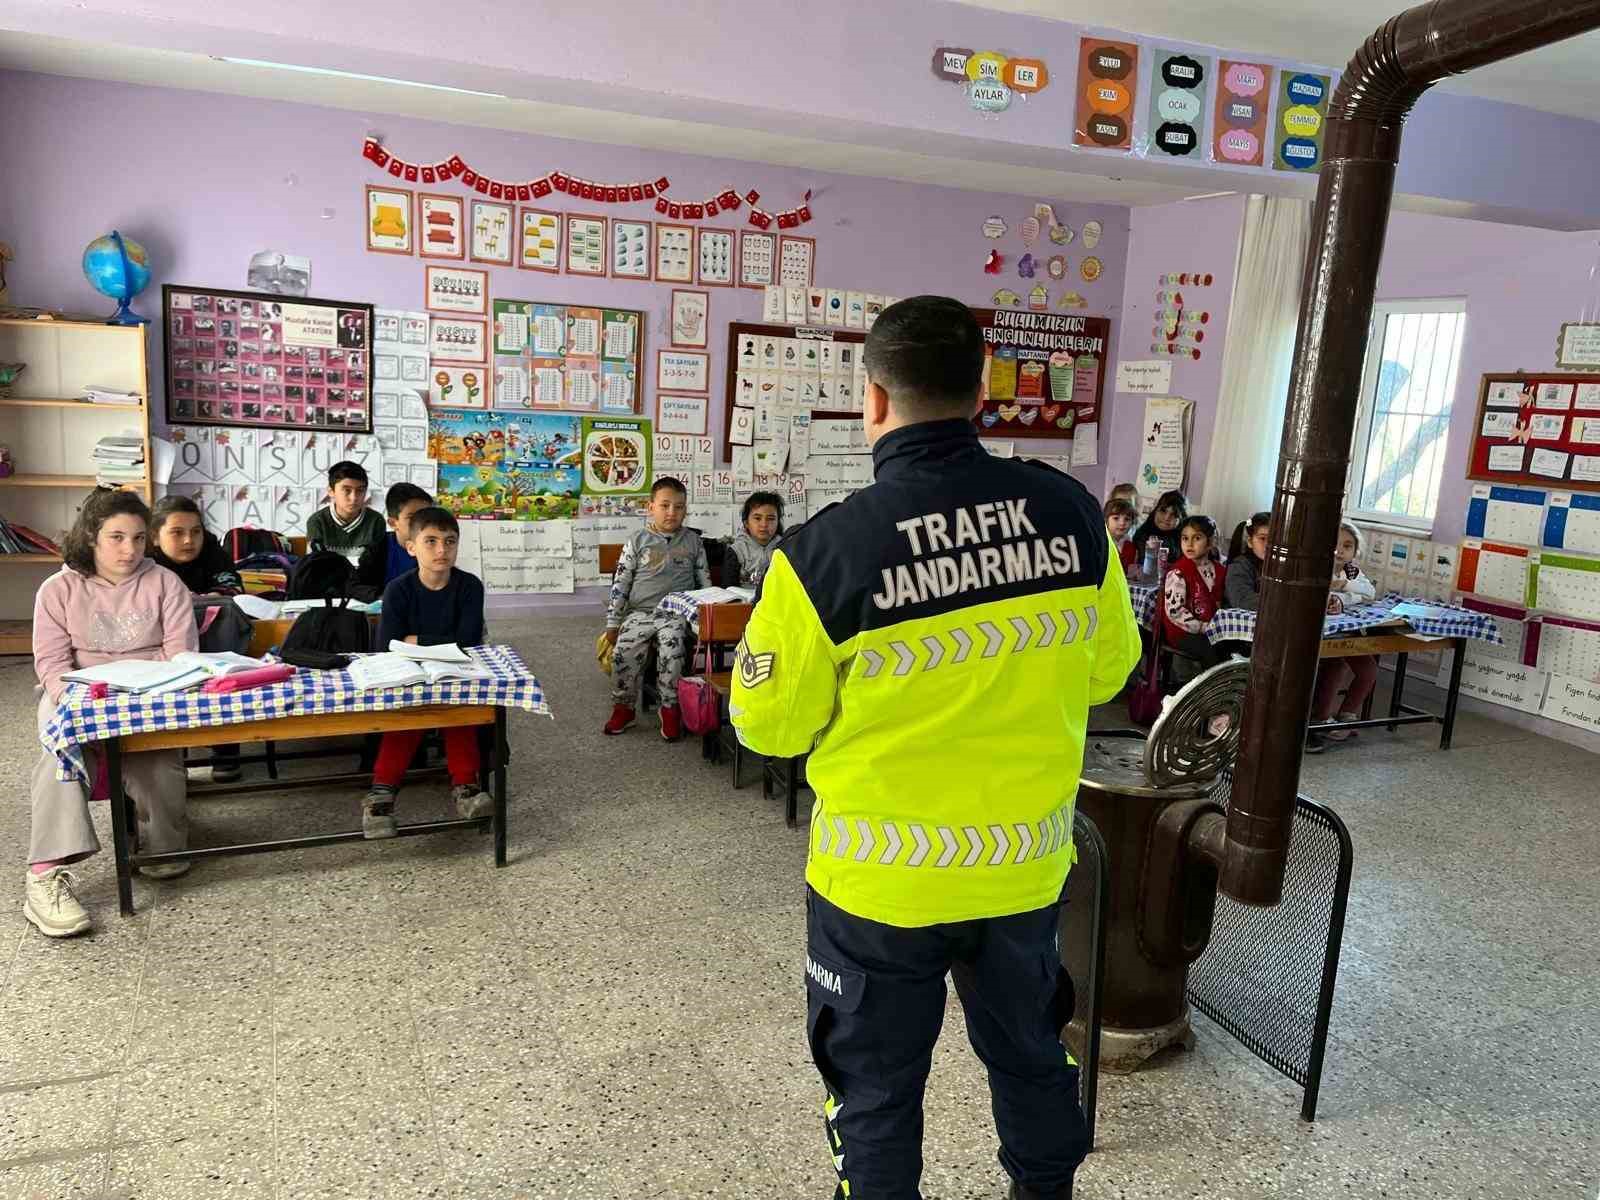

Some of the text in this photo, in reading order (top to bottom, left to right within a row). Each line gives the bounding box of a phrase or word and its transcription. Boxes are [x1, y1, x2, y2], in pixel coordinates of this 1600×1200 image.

[944, 56, 966, 69] MEV
[1018, 69, 1034, 81] LER
[974, 89, 1004, 100] AYLAR
[657, 437, 712, 454] 10 11 12
[696, 475, 711, 488] 15
[718, 472, 730, 485] 16
[789, 480, 803, 493] 20
[873, 534, 1082, 611] JANDARMASI
